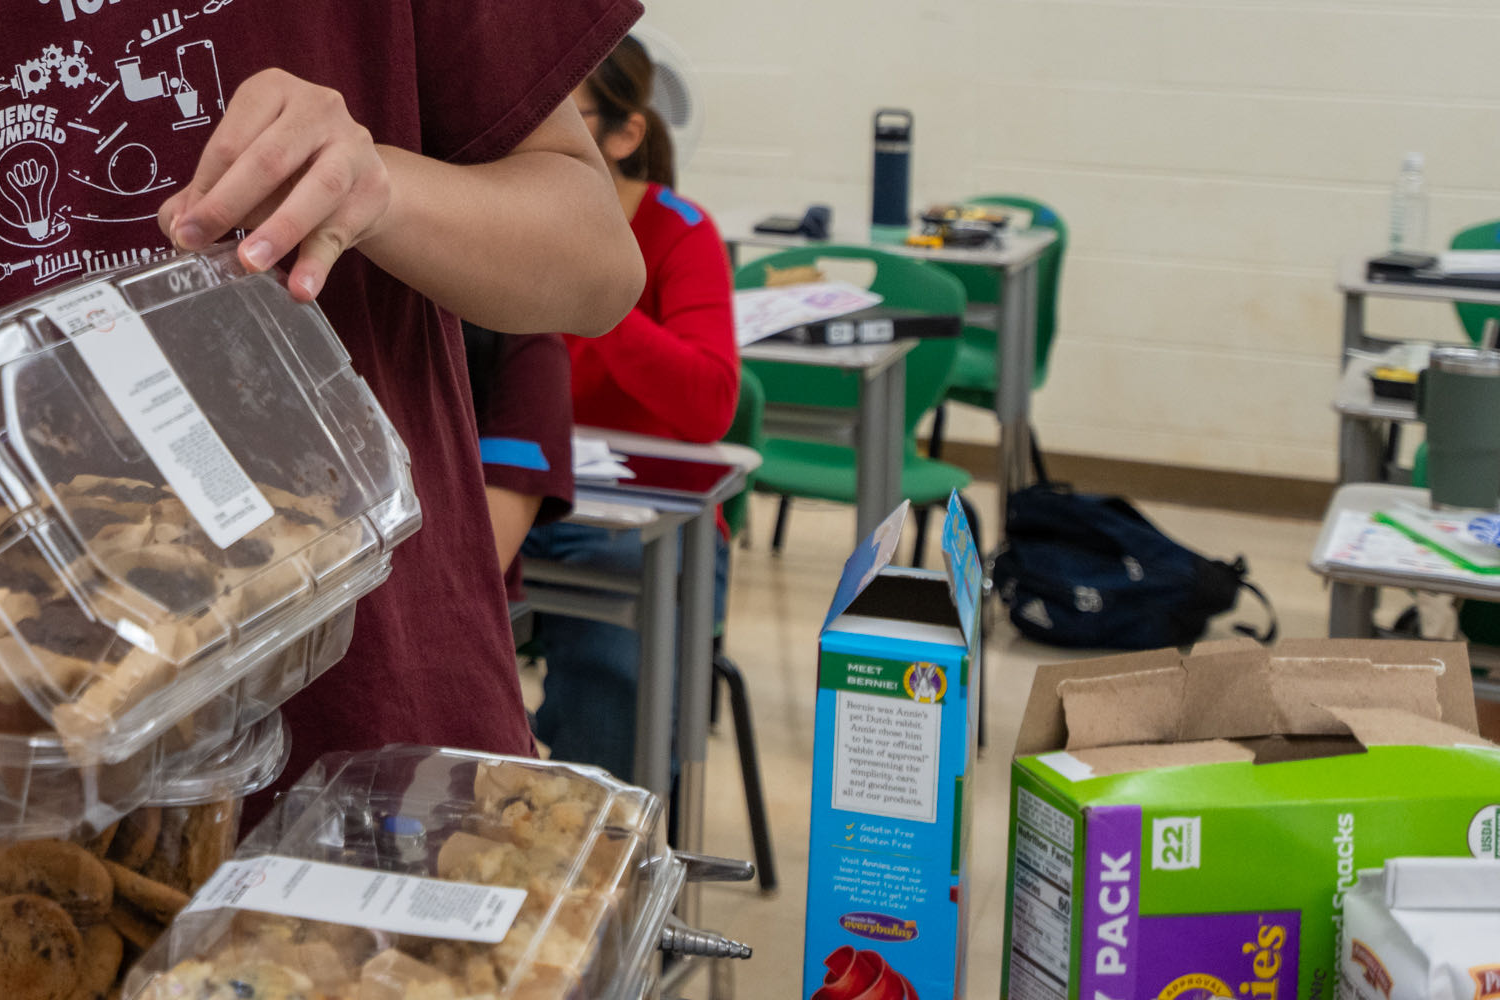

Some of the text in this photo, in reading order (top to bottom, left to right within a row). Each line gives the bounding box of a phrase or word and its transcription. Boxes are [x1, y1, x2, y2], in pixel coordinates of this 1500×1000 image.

[847, 663, 884, 676] MEET
[846, 676, 899, 691] BERNIE!
[846, 700, 928, 719] Bernie was Annie's
[849, 714, 923, 730] pet Dutch rabbit.
[850, 723, 923, 741] Annie chose him
[852, 735, 923, 751] to be our official
[876, 747, 886, 758] of
[848, 757, 921, 774] representing the
[849, 777, 918, 795] and goodness in
[842, 788, 923, 808] all of our products.
[860, 823, 915, 838] Gelatin Free
[1481, 818, 1493, 853] USDA
[860, 834, 912, 850] Gluten Free
[1017, 825, 1072, 868] Nutrition Facts
[1162, 825, 1184, 864] 22
[841, 856, 859, 865] Visit
[862, 858, 910, 873] Annies.com
[1331, 812, 1355, 911] Snacks
[861, 869, 881, 878] more
[883, 872, 906, 882] about
[833, 883, 859, 894] planet
[861, 887, 876, 896] and
[888, 892, 902, 902] get
[901, 883, 928, 895] better
[1058, 895, 1070, 916] 60
[1095, 851, 1132, 975] PACK
[843, 919, 914, 941] everybunny
